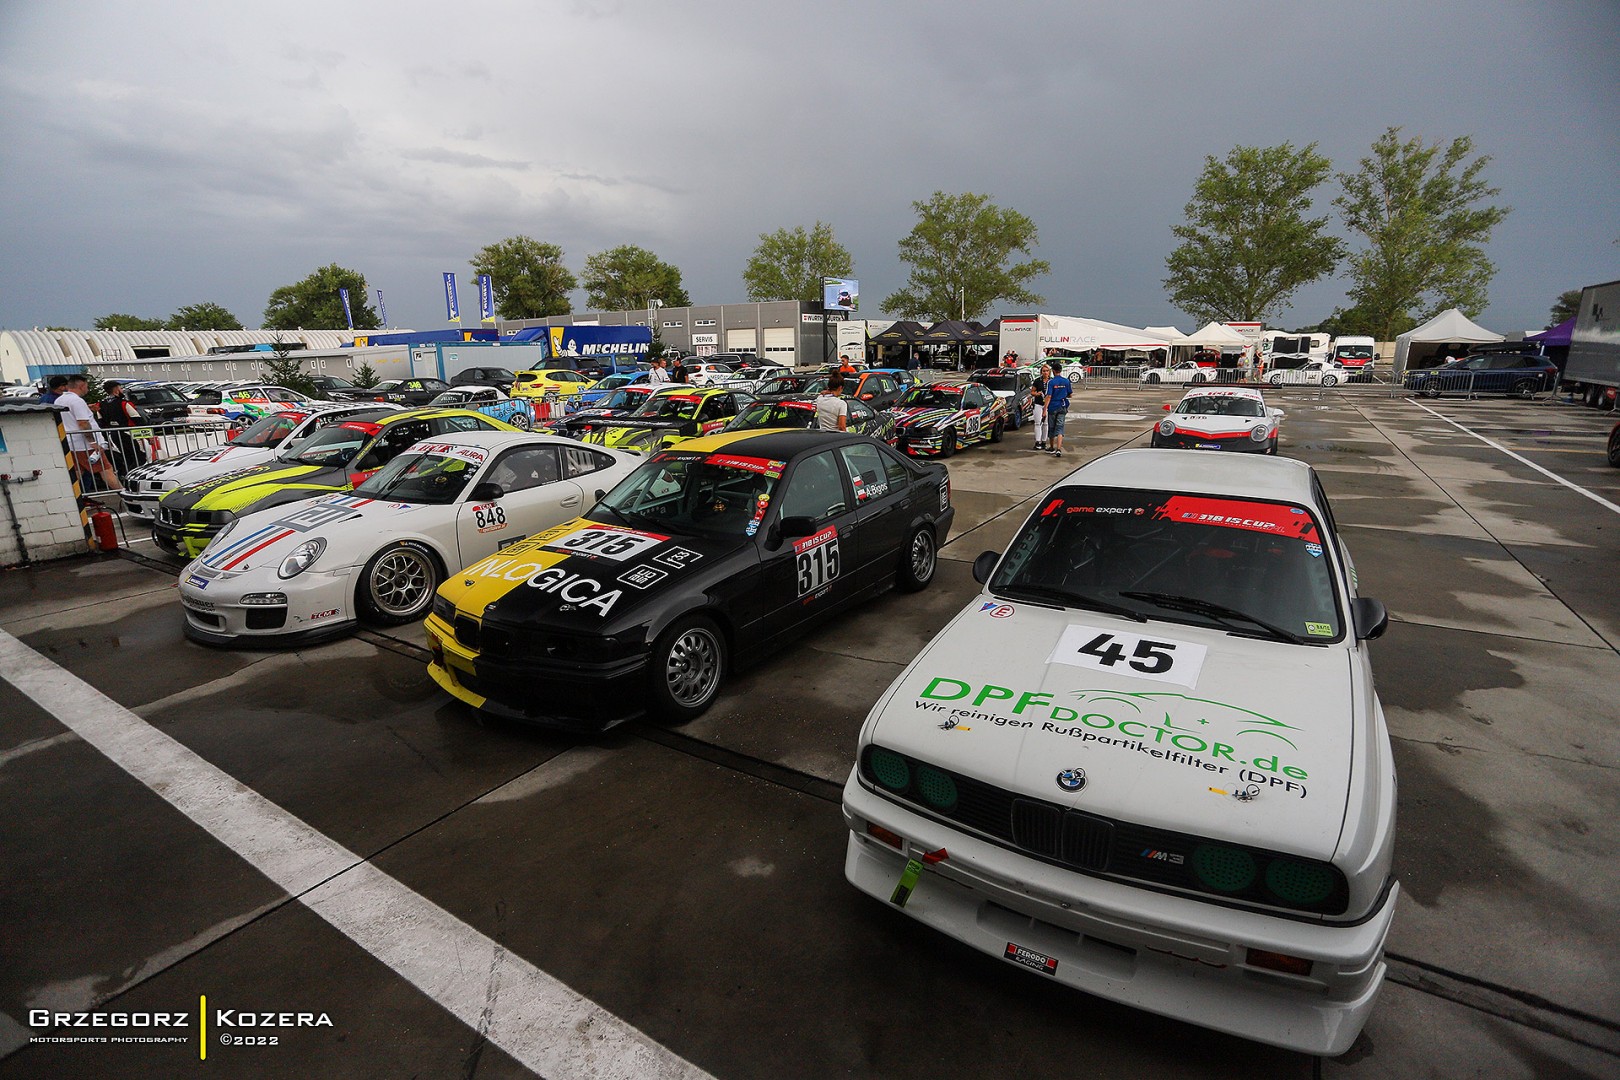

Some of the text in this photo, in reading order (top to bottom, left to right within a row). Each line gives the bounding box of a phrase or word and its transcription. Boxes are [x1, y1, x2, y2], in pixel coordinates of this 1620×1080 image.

[582, 343, 649, 355] MICHELIN
[238, 391, 251, 399] 46
[457, 449, 484, 462] AURA
[475, 507, 506, 528] 848
[1066, 506, 1133, 515] game expert
[1199, 513, 1223, 522] 318
[1225, 515, 1241, 524] IS
[1242, 518, 1276, 528] CUP
[564, 531, 646, 555] 315
[813, 536, 820, 544] IS
[820, 531, 832, 541] CUP
[798, 540, 839, 595] 315
[464, 558, 623, 617] INLOGICA
[1078, 633, 1177, 674] 45
[914, 700, 1308, 799] Wir reinigen Rußpartikelfilter (DPF)
[1015, 956, 1045, 971] RACING
[1016, 948, 1046, 964] FERODO
